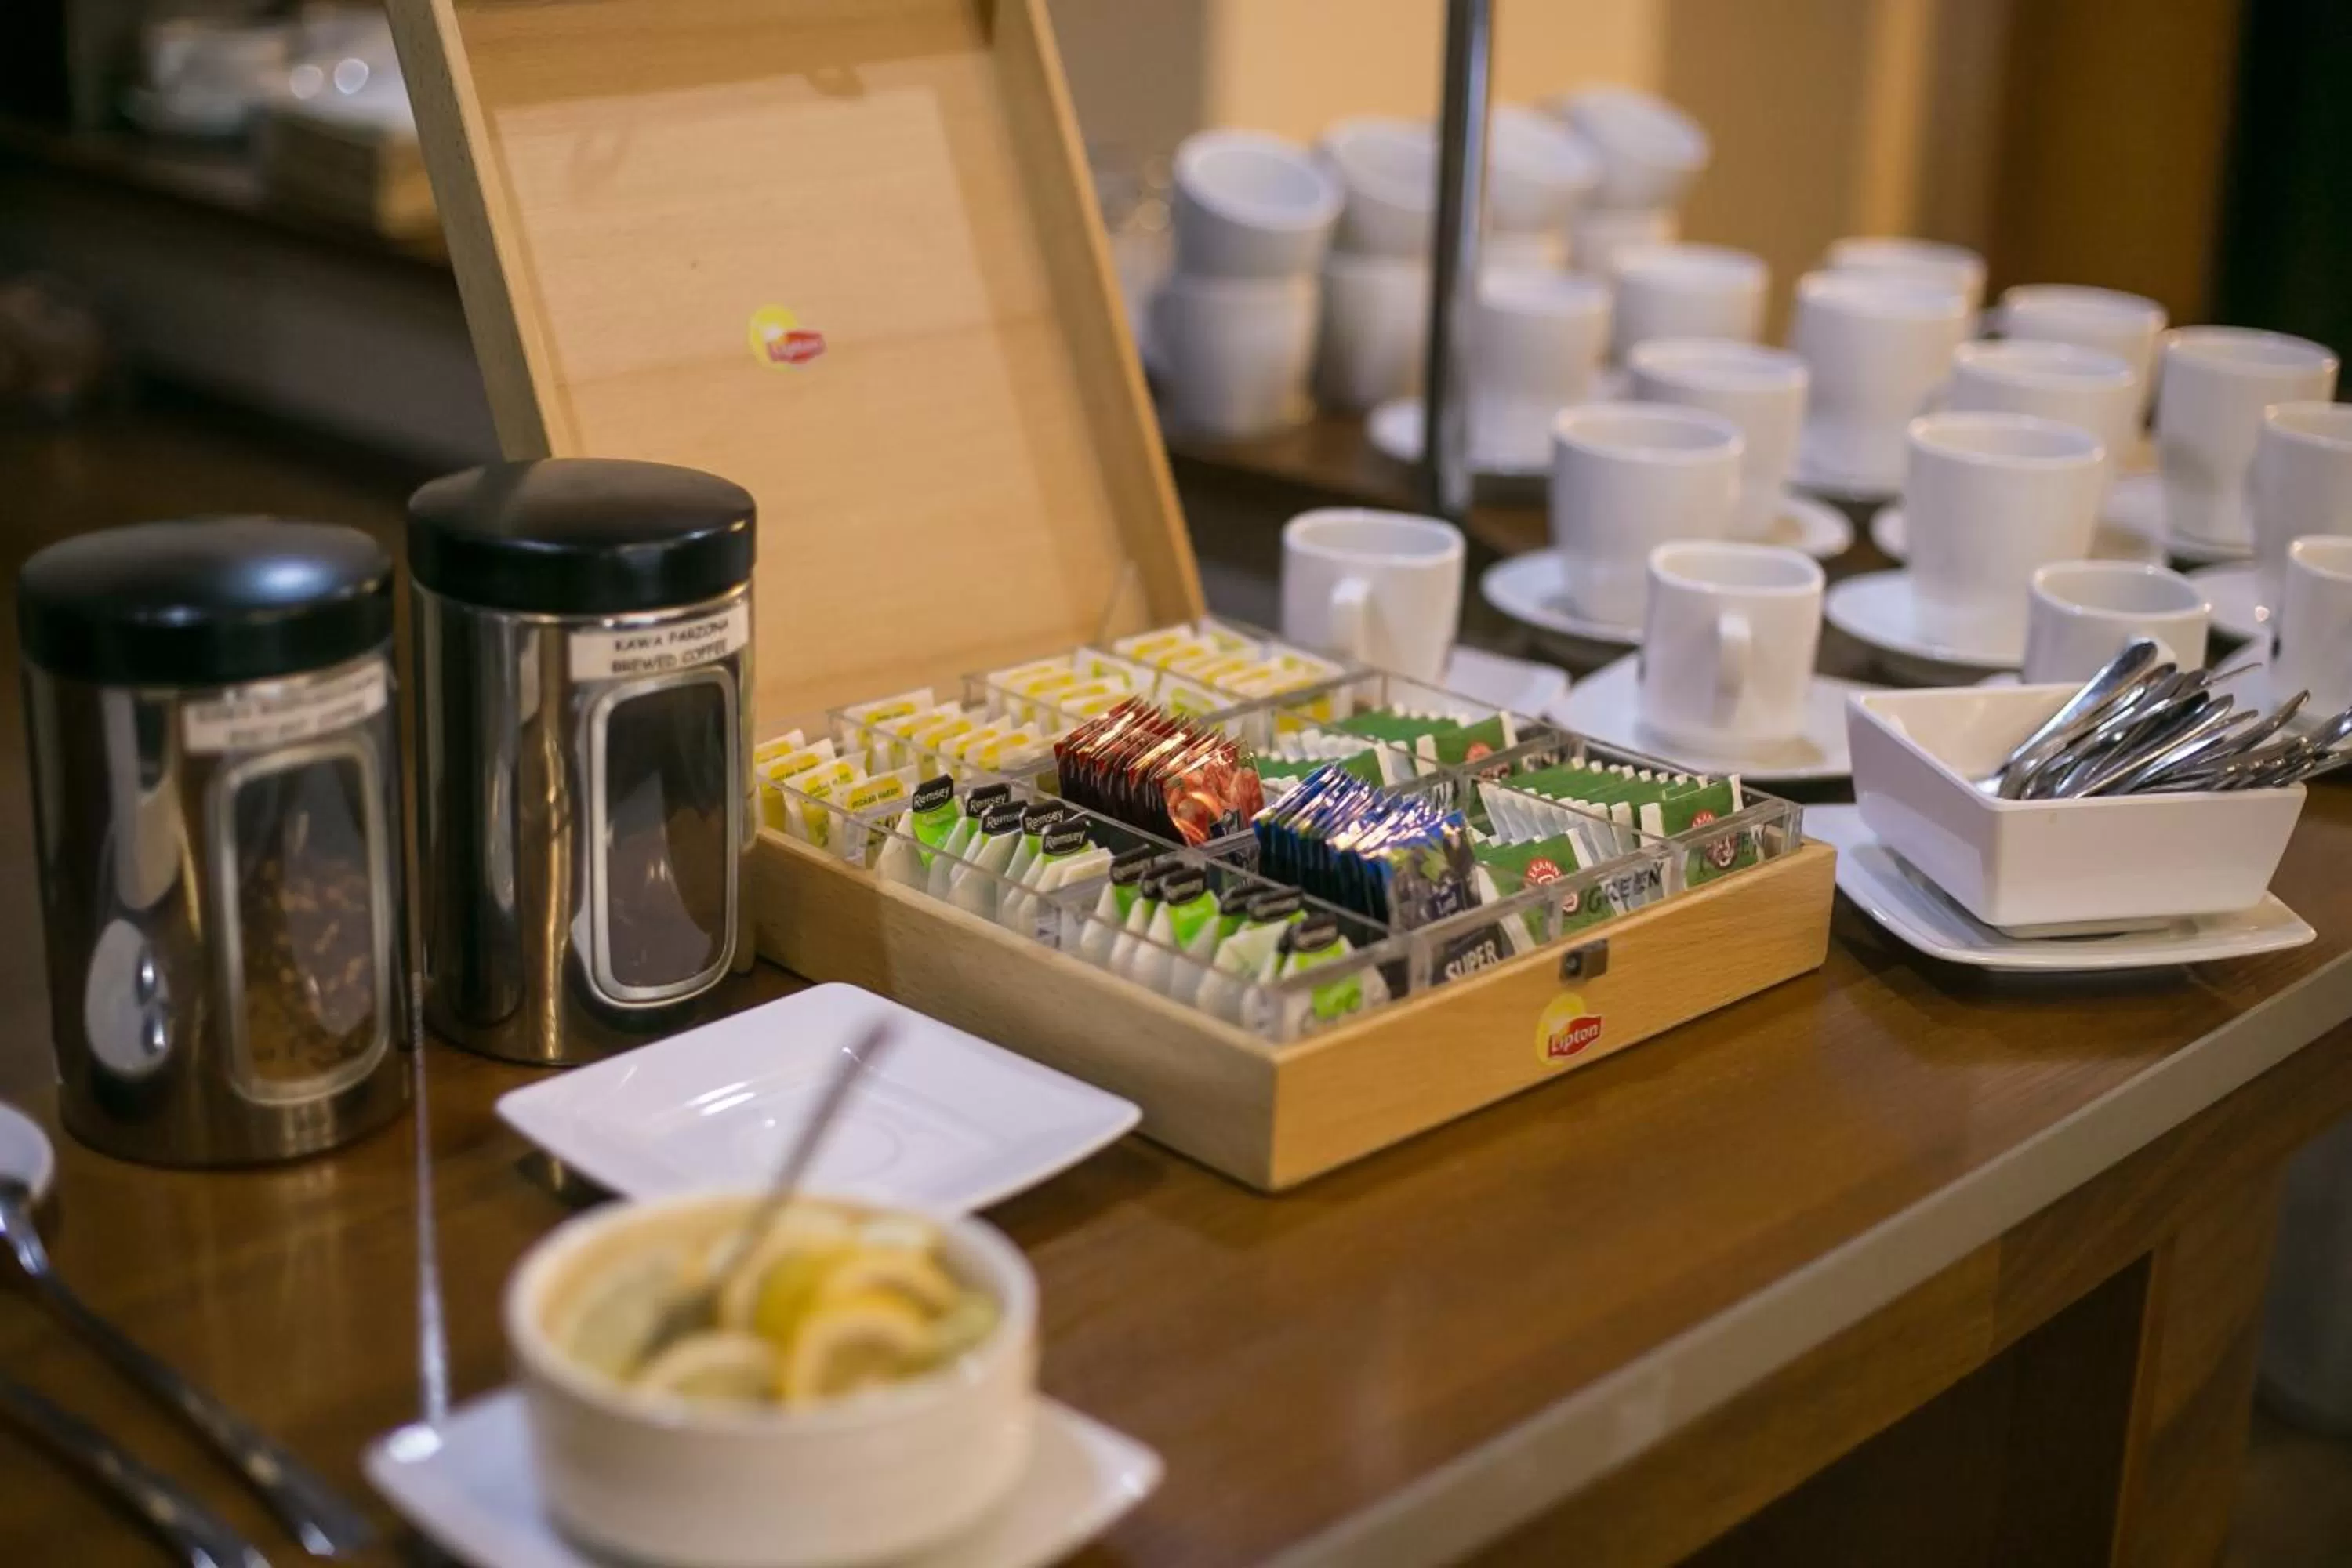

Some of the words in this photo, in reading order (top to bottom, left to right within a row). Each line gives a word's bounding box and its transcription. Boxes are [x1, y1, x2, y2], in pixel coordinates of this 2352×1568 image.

[913, 786, 951, 808] Remsey
[969, 793, 1007, 813] Remsey
[986, 813, 1021, 829] Rems
[1025, 809, 1065, 831] Remsey
[1045, 831, 1086, 850] Remsey
[1444, 938, 1499, 980] SUPER
[1551, 1024, 1599, 1054] Lipton
